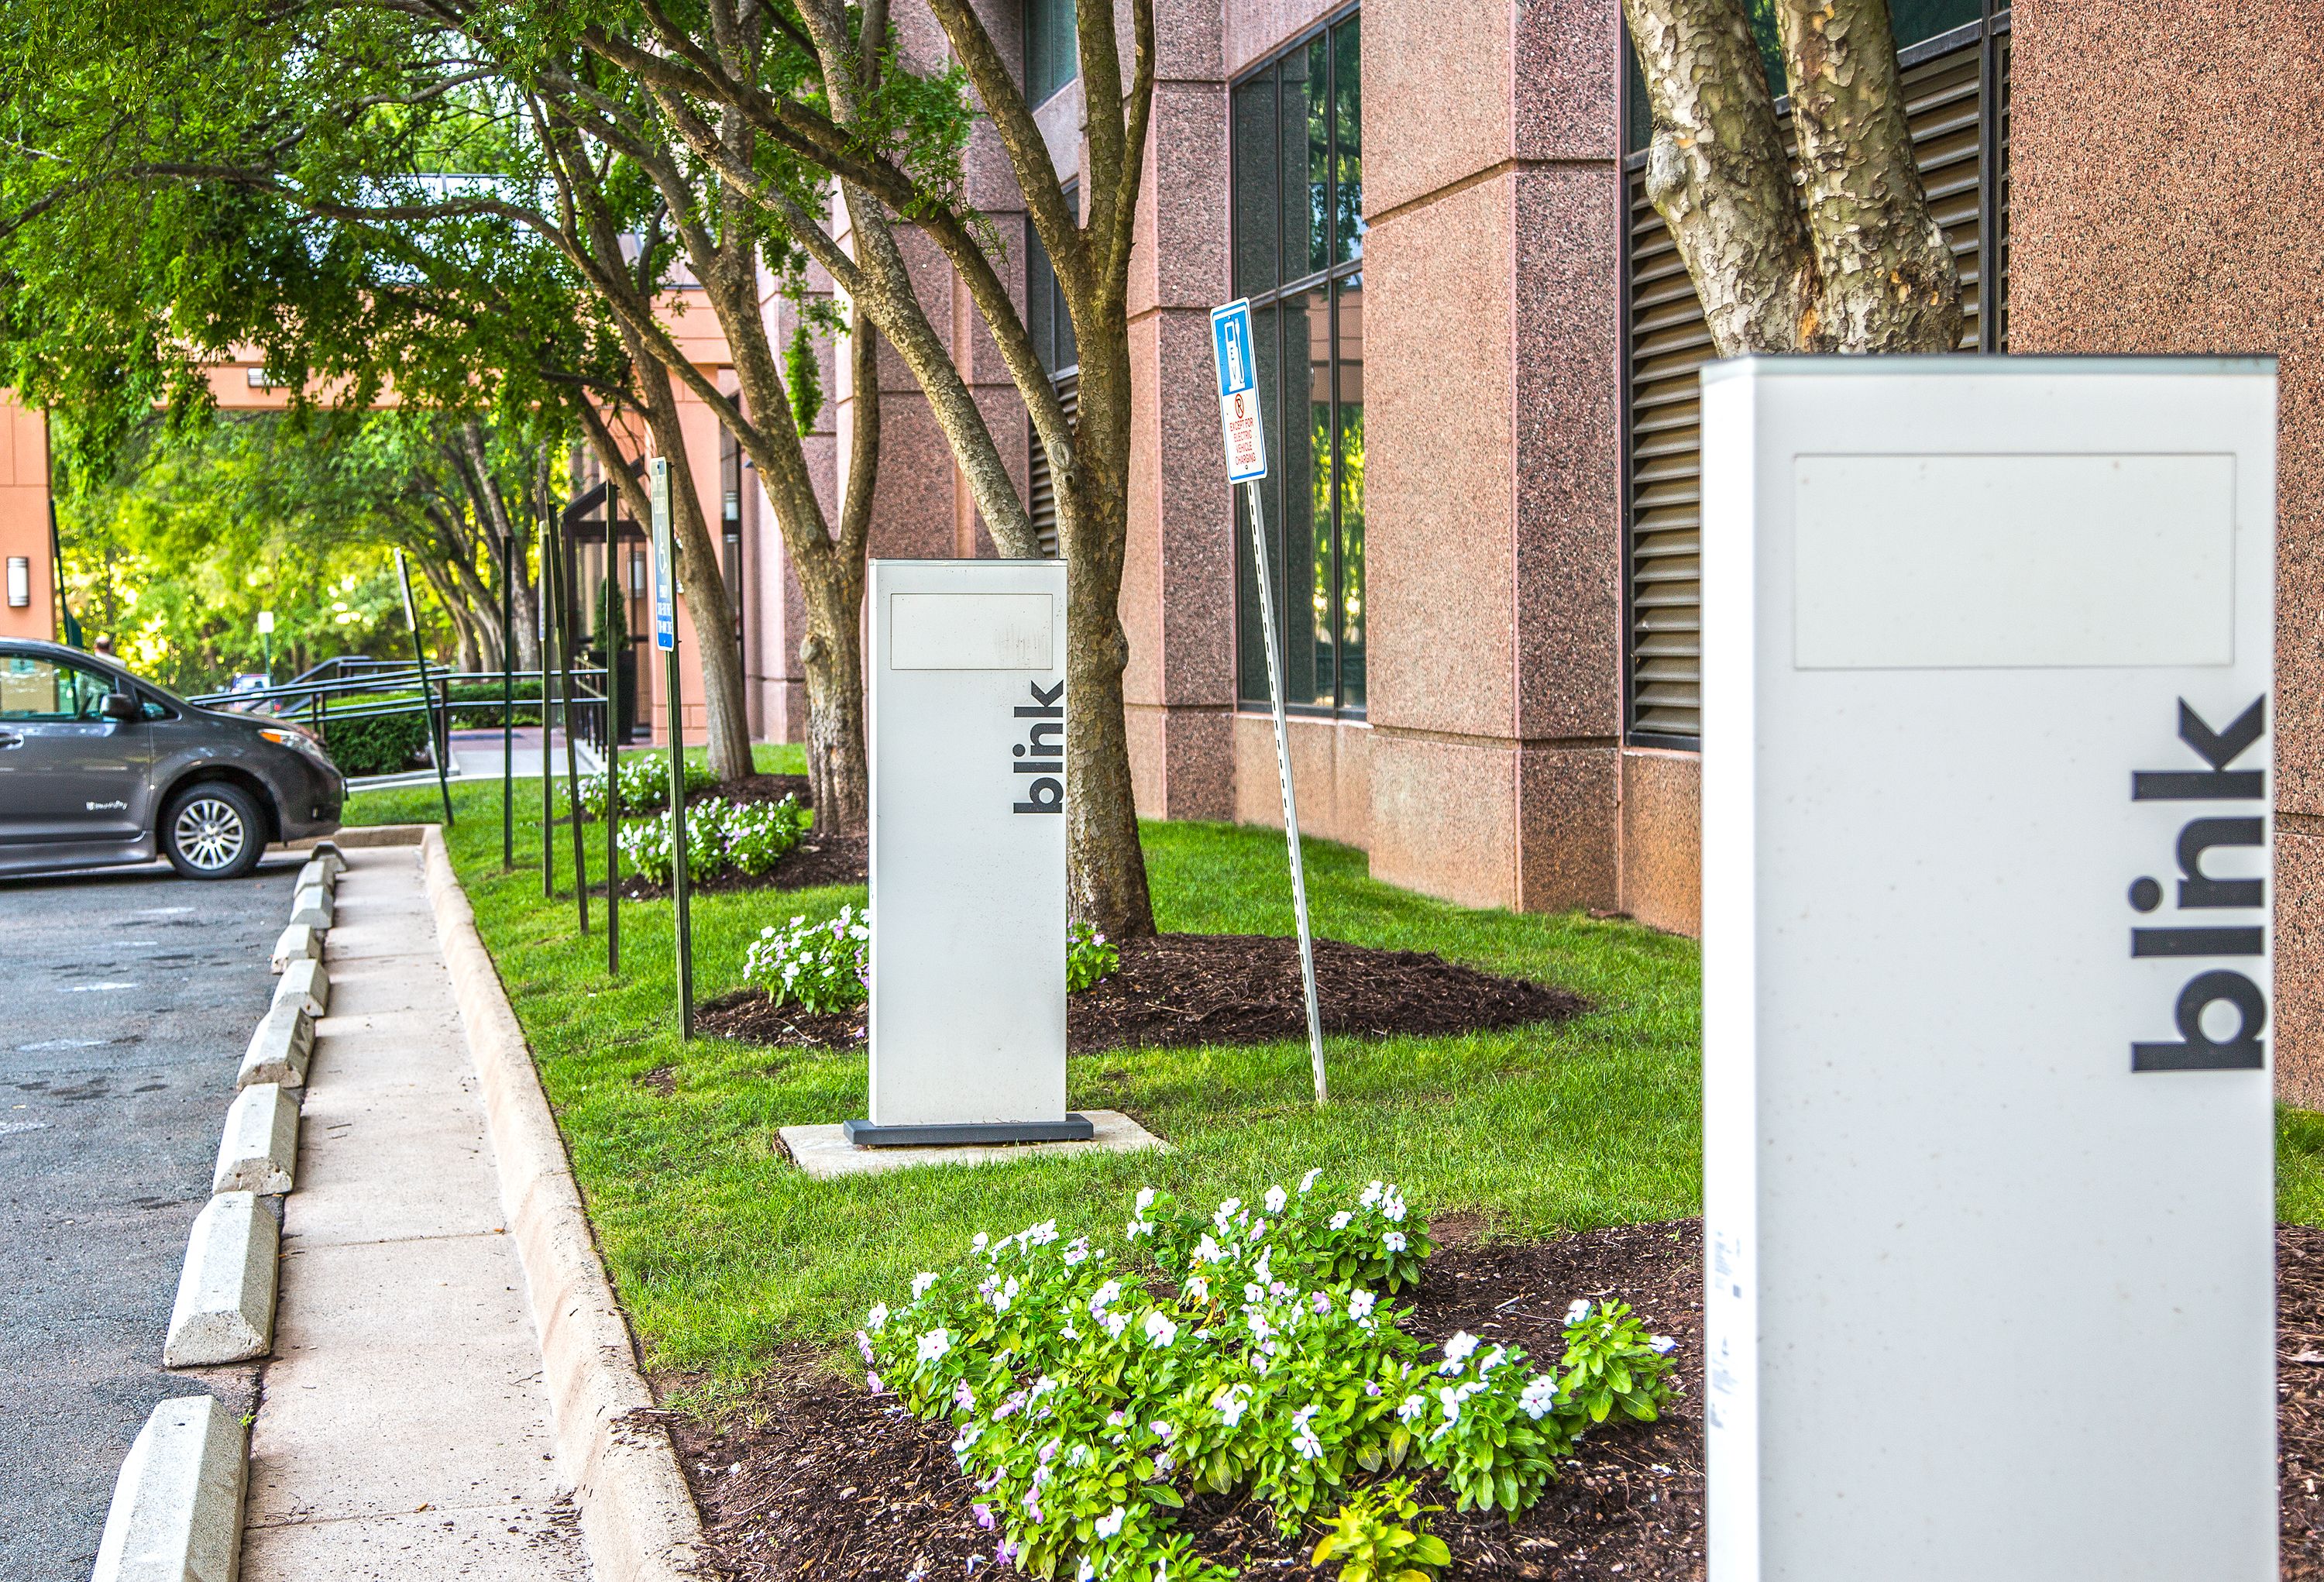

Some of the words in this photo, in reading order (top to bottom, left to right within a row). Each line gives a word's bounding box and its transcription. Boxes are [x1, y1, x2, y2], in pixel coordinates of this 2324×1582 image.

[1229, 420, 1245, 432] EXCEPT
[1245, 418, 1253, 428] FOR
[1233, 429, 1253, 442] ELECTRIC
[1236, 441, 1253, 453] VEHICLE
[1236, 452, 1256, 466] CHARGING
[1012, 679, 1064, 814] blink
[2127, 693, 2267, 1074] blink
